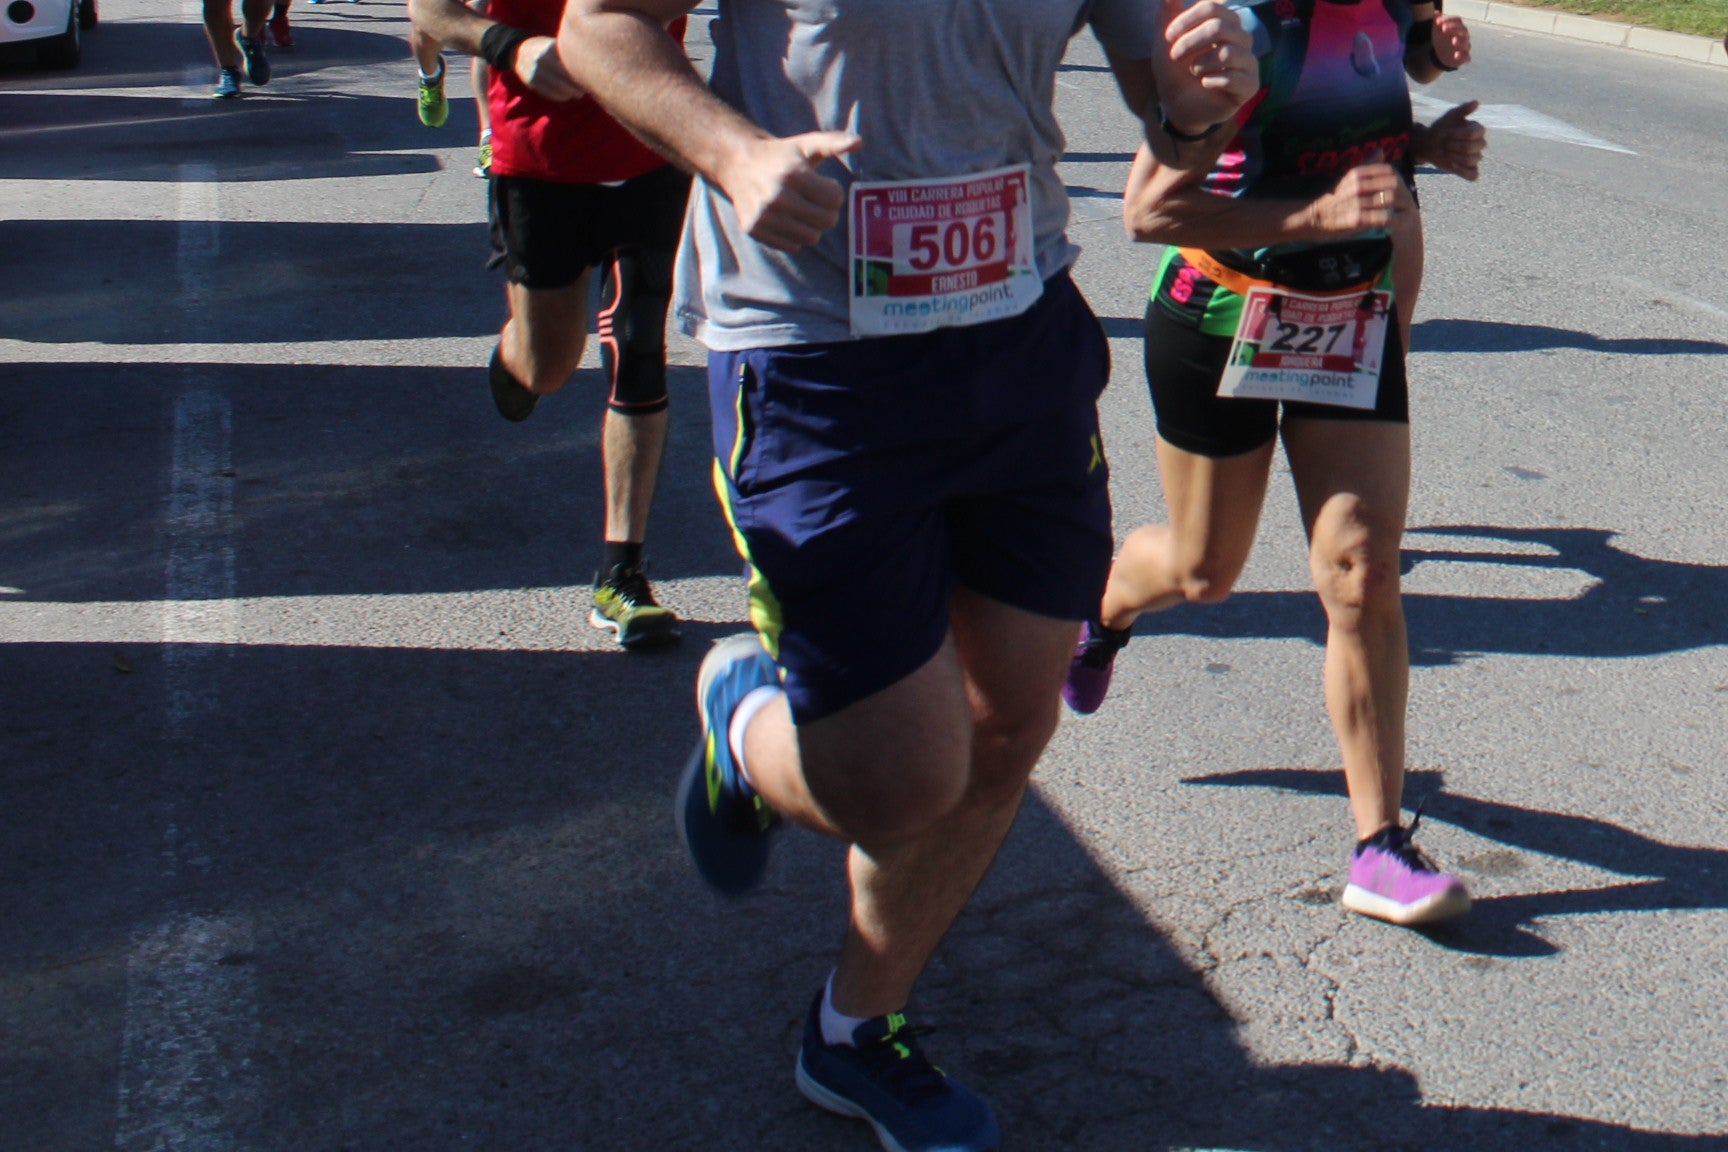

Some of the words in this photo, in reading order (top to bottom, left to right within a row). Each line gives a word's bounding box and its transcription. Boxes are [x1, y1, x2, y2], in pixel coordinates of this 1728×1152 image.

[888, 190, 909, 203] VIII
[911, 187, 964, 202] CARRERA
[966, 177, 1004, 198] POPULAR
[888, 206, 935, 221] CIUDAD
[938, 204, 951, 218] DE
[908, 215, 997, 271] 506
[931, 270, 978, 294] ERNESTO
[883, 284, 1014, 317] meetingpoint
[1270, 322, 1347, 353] 227
[1244, 369, 1356, 389] meetingpoint
